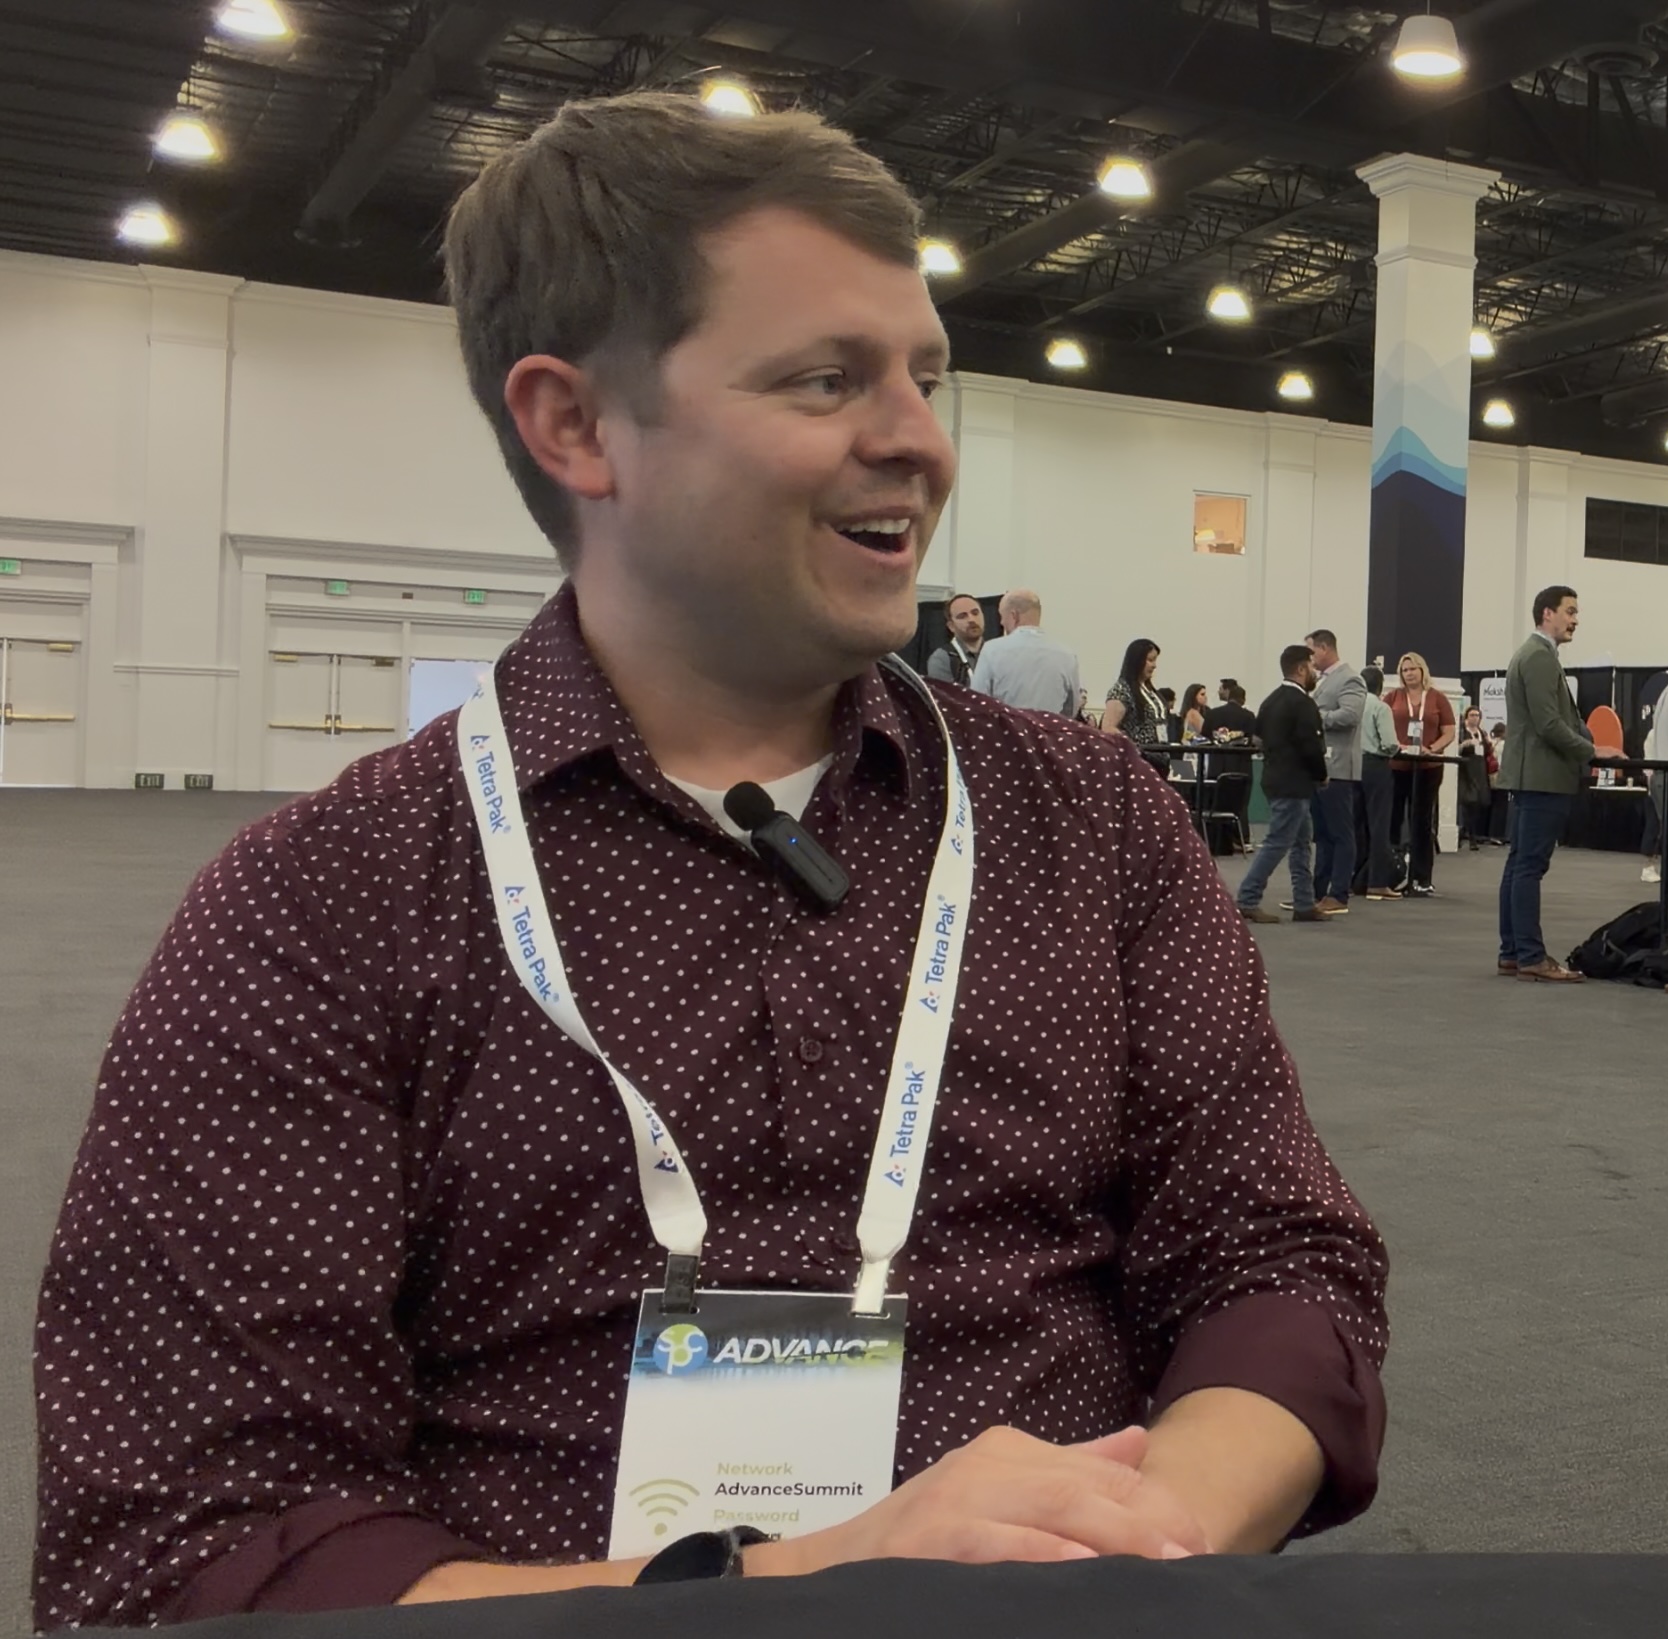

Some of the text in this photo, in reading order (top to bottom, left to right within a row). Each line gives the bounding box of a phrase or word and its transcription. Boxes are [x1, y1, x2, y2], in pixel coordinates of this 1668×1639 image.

[476, 751, 497, 797] Tetra
[512, 906, 536, 959] Tetra
[925, 940, 949, 984] Tetra
[890, 1110, 918, 1157] Tetra
[713, 1337, 888, 1365] ADVANCE
[717, 1463, 792, 1476] Network
[714, 1482, 863, 1496] AdvanceSummit
[713, 1509, 799, 1523] Password
